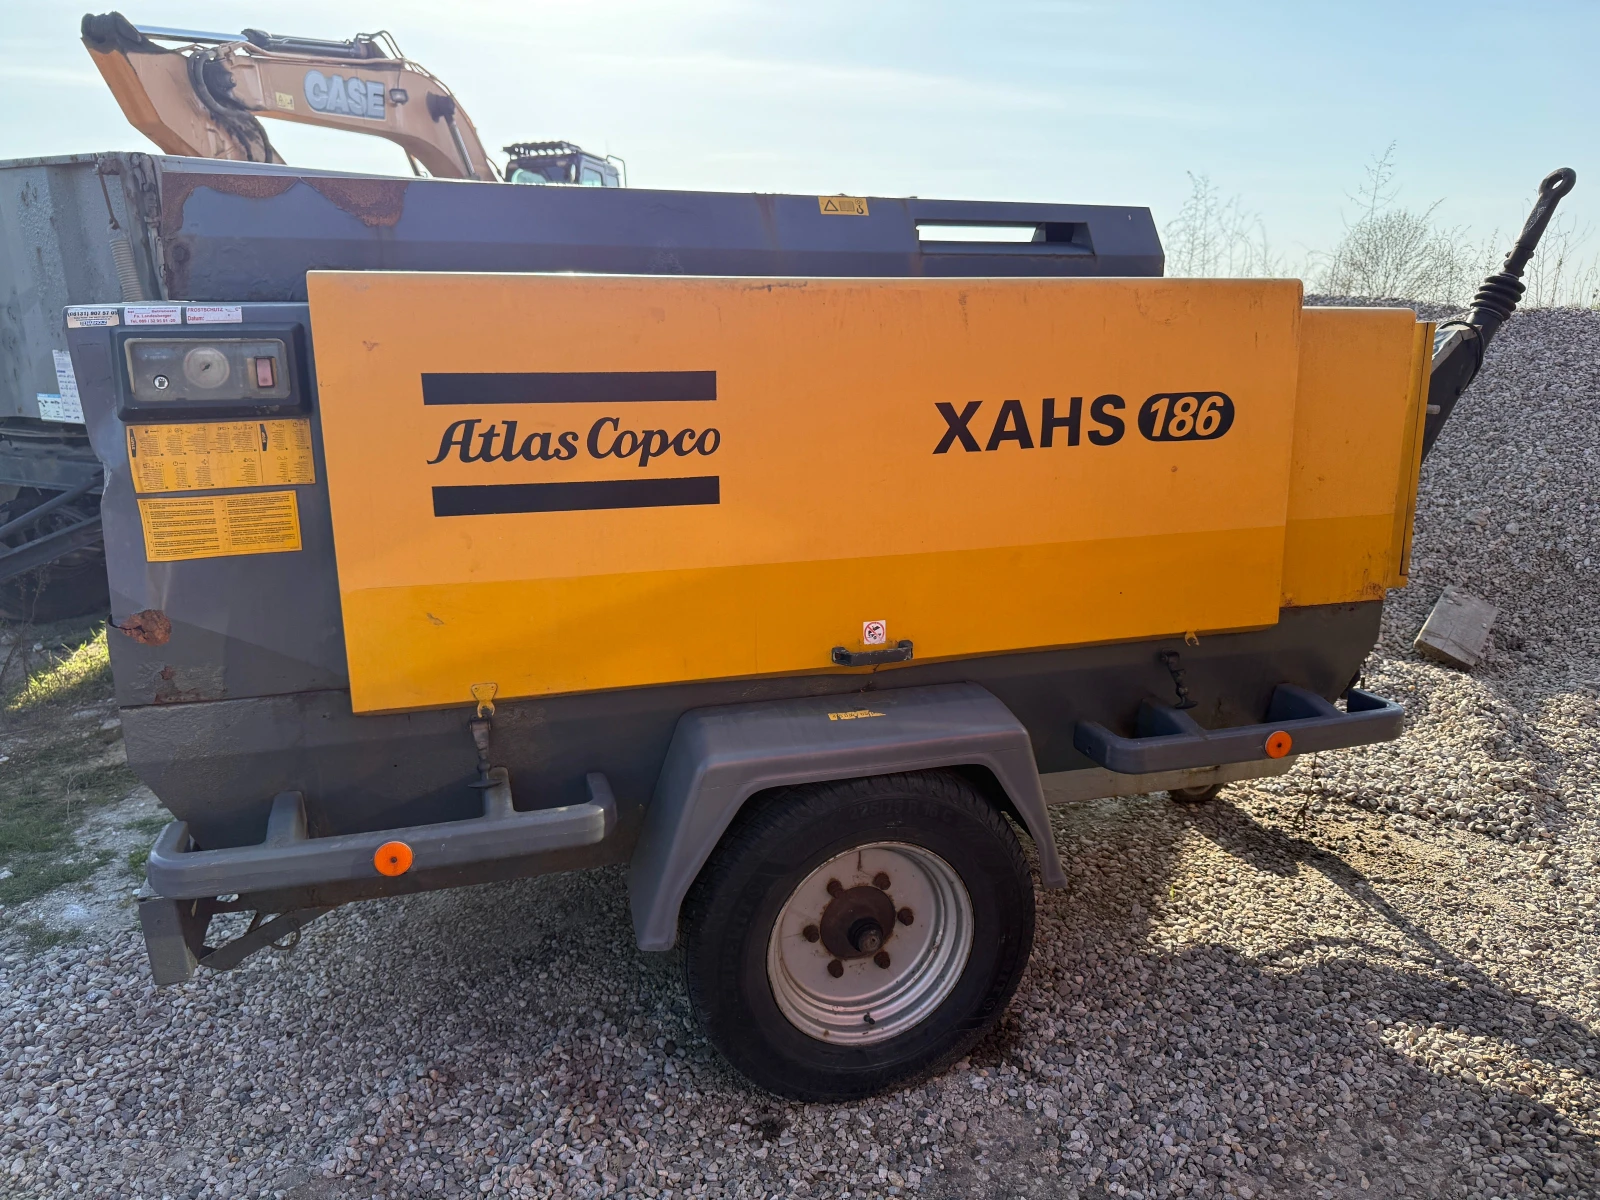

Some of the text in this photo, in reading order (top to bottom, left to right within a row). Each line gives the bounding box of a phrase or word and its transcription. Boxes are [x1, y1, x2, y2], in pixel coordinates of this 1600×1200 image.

[304, 69, 385, 119] CASE
[427, 416, 721, 467] Atlas Copco
[932, 394, 1224, 455] XAHS 186
